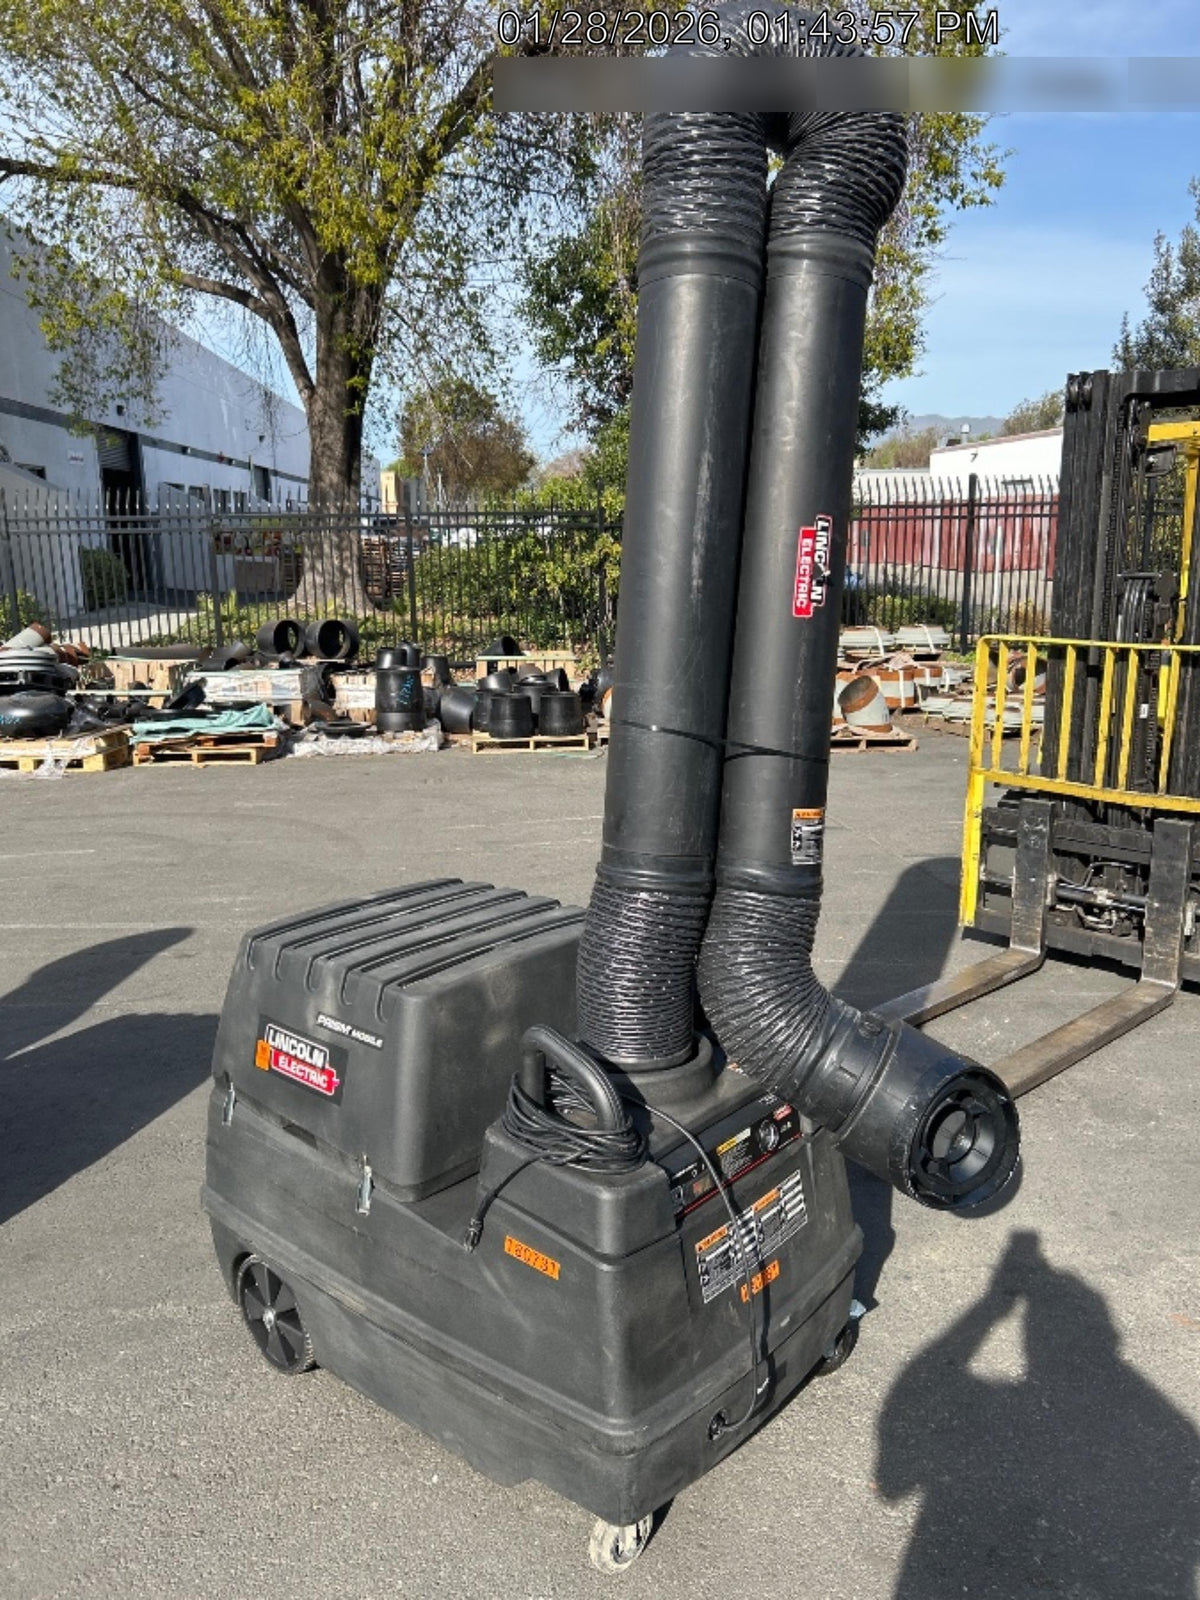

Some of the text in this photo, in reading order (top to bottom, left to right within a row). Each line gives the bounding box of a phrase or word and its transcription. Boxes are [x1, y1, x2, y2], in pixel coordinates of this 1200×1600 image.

[796, 538, 813, 608] ELECTRIC
[810, 520, 829, 601] LINCN
[268, 1028, 325, 1069] LINCOLN
[277, 1055, 328, 1088] ELECTRIC
